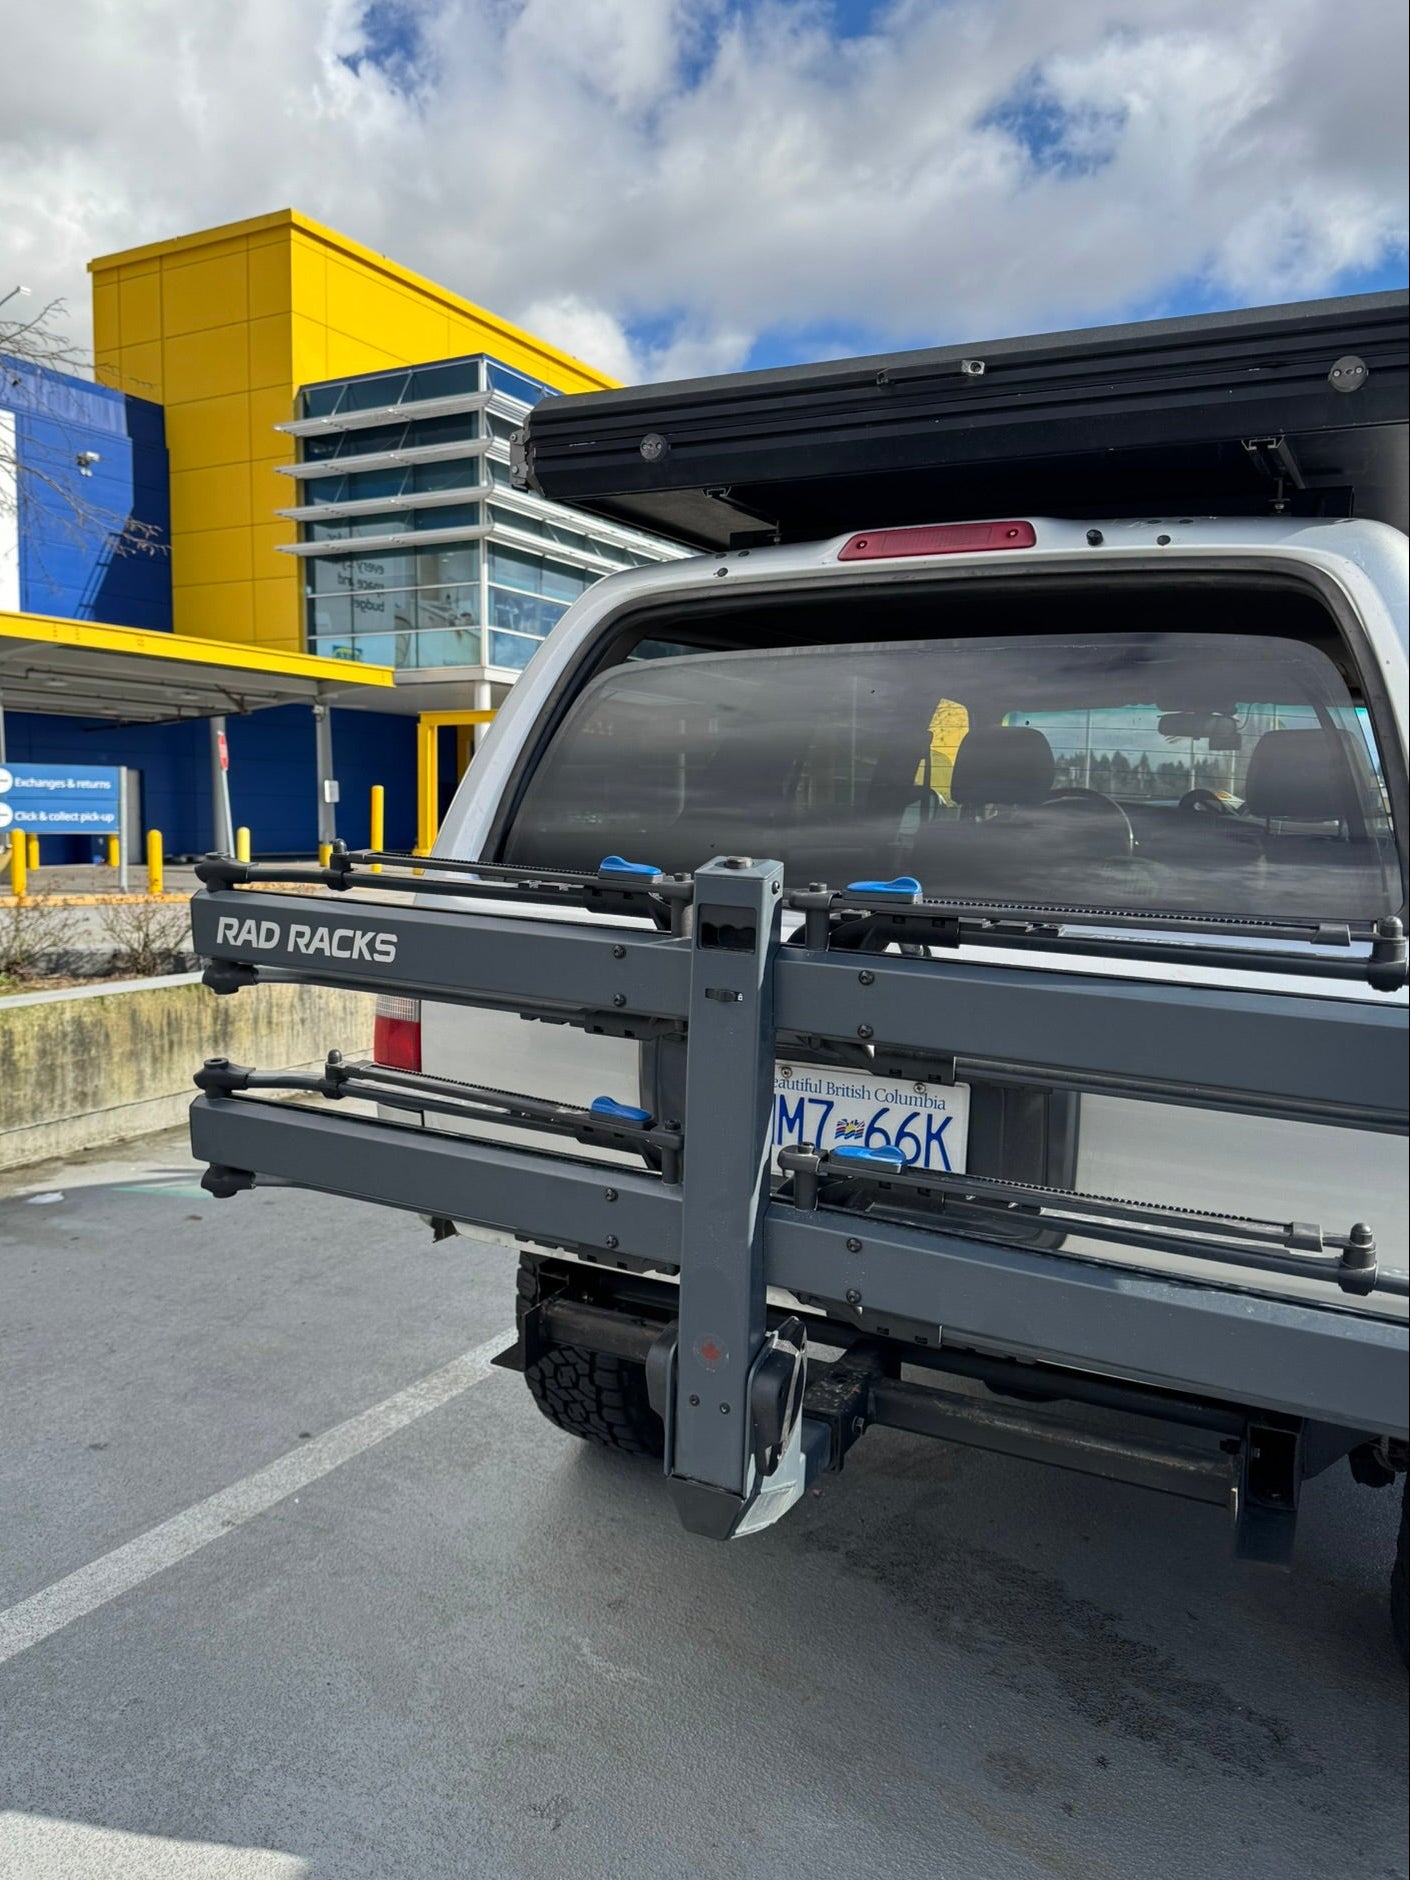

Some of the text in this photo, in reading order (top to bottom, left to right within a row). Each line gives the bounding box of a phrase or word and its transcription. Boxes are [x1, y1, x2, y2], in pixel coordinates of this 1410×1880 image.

[14, 777, 111, 790] Exchanges & returns
[14, 811, 115, 824] Click & collect pick-up
[217, 917, 398, 963] RAD RACKS
[774, 1077, 946, 1111] eautiful British Columbia
[772, 1094, 834, 1150] M7
